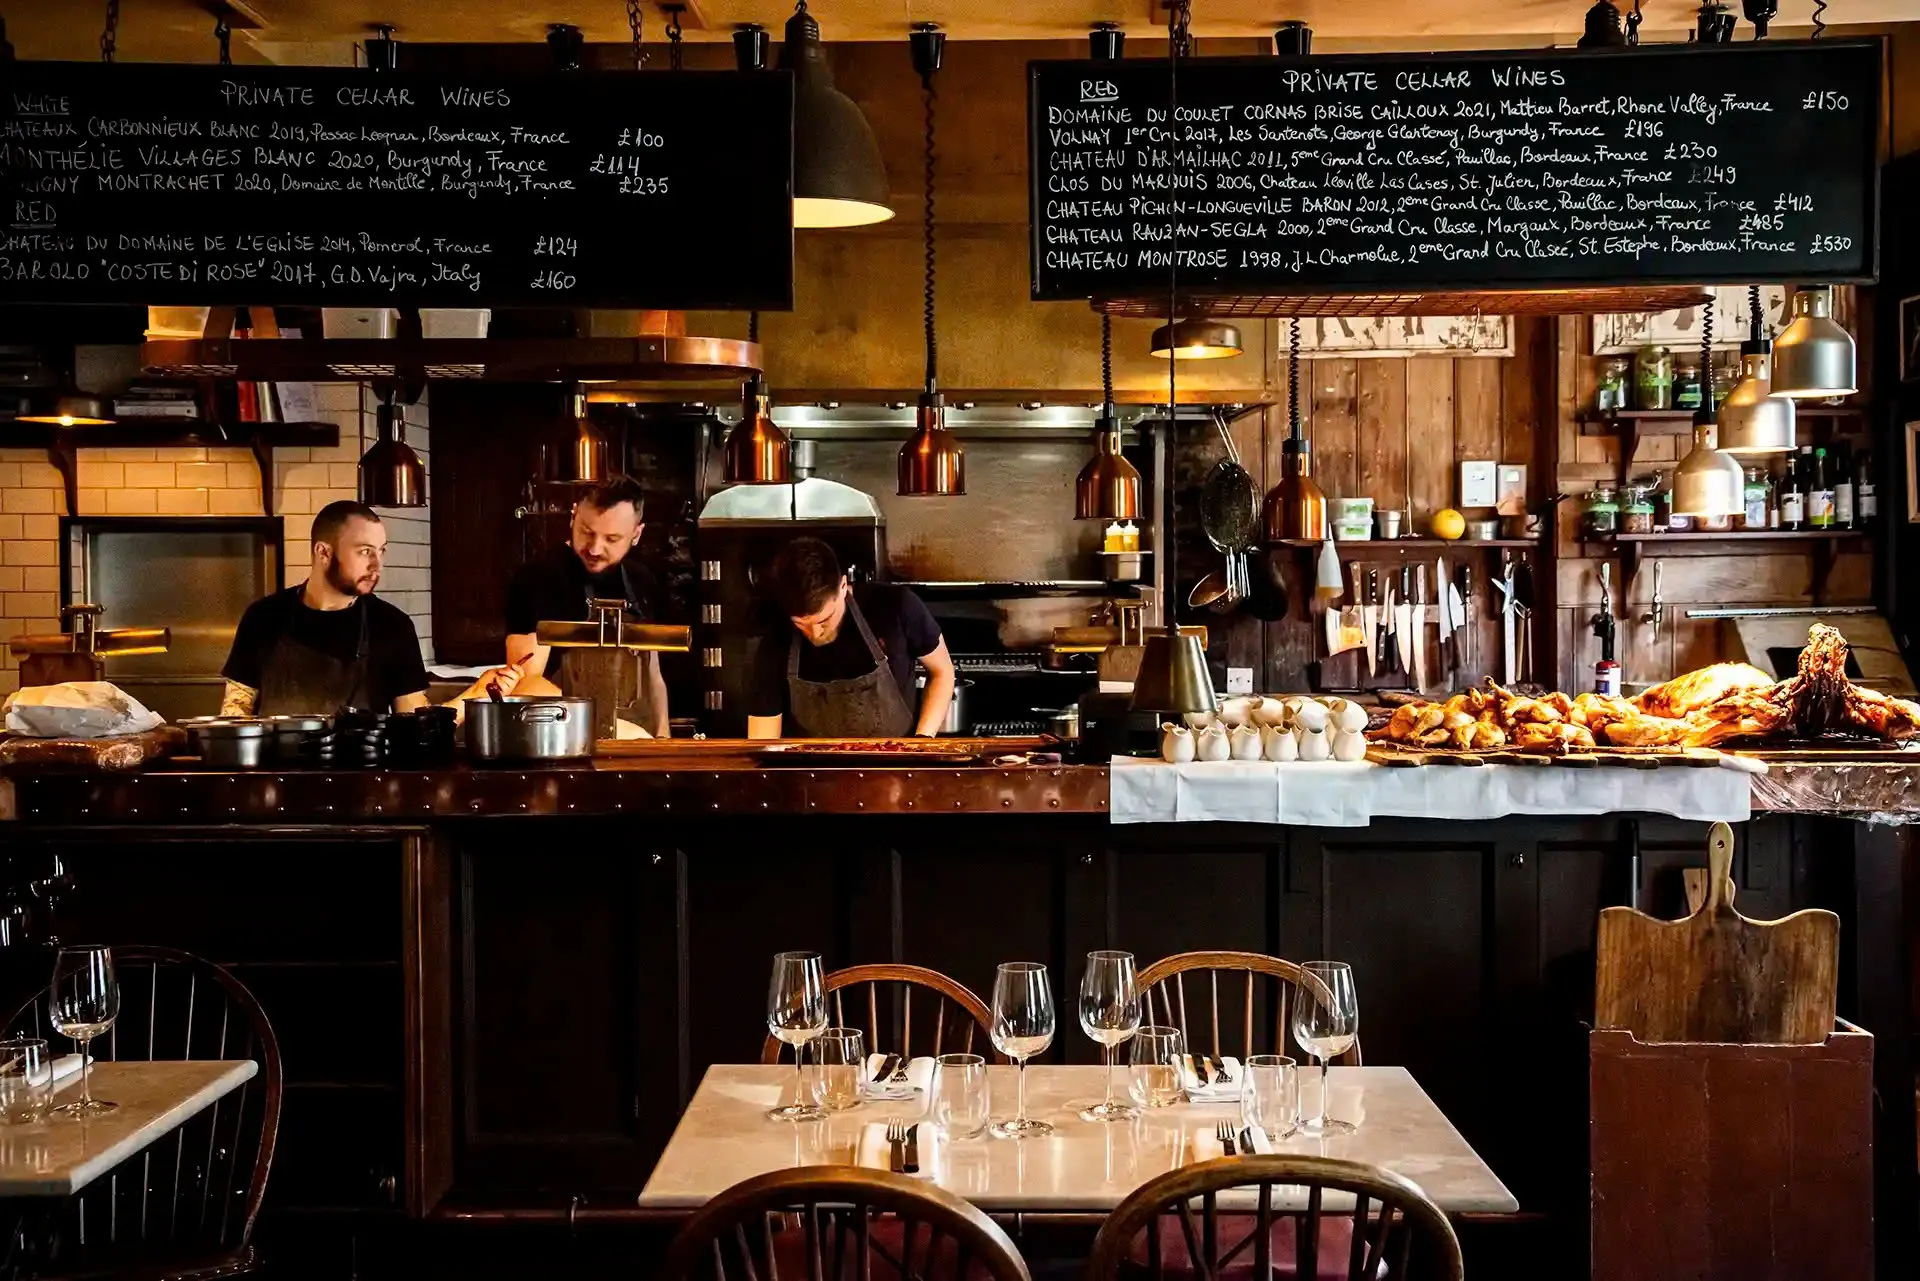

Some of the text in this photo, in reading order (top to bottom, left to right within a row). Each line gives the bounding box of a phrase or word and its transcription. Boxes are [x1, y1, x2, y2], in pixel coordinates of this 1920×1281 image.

[221, 80, 511, 107] PRIVATE CELLAR WINES
[1080, 80, 1119, 99] RED
[1282, 66, 1565, 93] PRIVATE CELLAR WINES
[13, 92, 70, 113] WHITE
[1049, 105, 1132, 124] DOMAINE
[1147, 107, 1167, 122] DU
[1174, 105, 1234, 122] COULET
[1244, 104, 1307, 120] CORNAS
[1314, 101, 1364, 120] BRISE
[1370, 100, 1449, 120] CAILLOUX
[1453, 100, 1496, 121] 2021,
[1617, 96, 1667, 114] Rhone
[1669, 93, 1722, 124] Valley,
[1721, 93, 1773, 113] France
[1803, 91, 1849, 110] £150
[88, 116, 201, 137] CARBONNIEUX
[211, 120, 260, 138] BLANC
[269, 122, 309, 143] 2019,
[310, 123, 358, 142] Pessac
[429, 126, 506, 145] Bordeaux,
[510, 127, 570, 143] France
[617, 128, 664, 147] £100
[1049, 128, 1110, 147] VOLNAY
[1185, 126, 1223, 144] 2017,
[1229, 125, 1252, 142] Les
[1333, 125, 1384, 150] George
[1468, 123, 1545, 145] Burgundy,
[1549, 122, 1605, 138] France
[1624, 119, 1664, 138] £196
[138, 145, 242, 167] VILLAGES
[255, 147, 316, 166] BLANC
[328, 150, 379, 172] 2020,
[388, 150, 482, 177] Burgundy,
[486, 150, 548, 172] France
[590, 154, 640, 177] £114
[1050, 150, 1125, 172] CHATEAU
[1247, 150, 1288, 170] 2011,
[1320, 152, 1365, 167] Grand
[1368, 153, 1393, 166] Cru
[1520, 148, 1596, 165] Bordeaux,
[1595, 145, 1649, 162] France
[1664, 142, 1718, 160] £230
[98, 174, 224, 192] MONTRACHET
[234, 174, 277, 194] 2020,
[282, 174, 343, 191] Domaine
[346, 175, 364, 190] de
[441, 175, 518, 199] Burgundy,
[518, 175, 576, 192] France
[619, 176, 668, 195] £235
[1048, 175, 1089, 193] CLOS
[1101, 176, 1123, 192] DU
[1216, 173, 1256, 192] 2006,
[1259, 172, 1317, 190] Chateau
[1323, 168, 1376, 190] Léoville
[1379, 172, 1404, 190] Las
[1408, 172, 1455, 191] Cases,
[1459, 173, 1482, 190] St.
[1485, 172, 1539, 197] Julien,
[1542, 171, 1621, 189] Bordeaux,
[1620, 168, 1672, 187] France
[1687, 165, 1736, 184] £249
[15, 199, 57, 222] RED
[1047, 200, 1123, 219] CHATEAU
[1302, 196, 1352, 214] BARON
[1355, 196, 1395, 214] 2012,
[1431, 196, 1479, 211] Grand
[1480, 198, 1503, 211] Cru
[1626, 192, 1701, 213] Bordeaux,
[1774, 192, 1814, 212] £412
[1046, 225, 1123, 245] CHATEAU
[1277, 219, 1314, 238] 2000,
[1350, 217, 1395, 234] Grand
[1398, 219, 1428, 236] Cru
[1487, 216, 1567, 241] Margaux,
[1571, 213, 1653, 232] Bordeaux,
[1655, 214, 1711, 231] France
[1738, 213, 1784, 232] £485
[86, 235, 108, 251] DU
[119, 234, 195, 251] DOMAINE
[204, 236, 227, 250] DE
[236, 232, 314, 251] L'EGLISE
[320, 236, 355, 253] 2014,
[358, 232, 430, 254] Pomerol,
[433, 238, 492, 253] France
[534, 236, 577, 257] £124
[1046, 250, 1128, 270] CHATEAU
[1137, 248, 1228, 268] MONTROSE
[1239, 250, 1287, 269] 1998,
[1443, 240, 1489, 261] Grand
[1496, 240, 1521, 258] Cru
[1578, 236, 1601, 255] St.
[1671, 234, 1740, 253] Bordeaux,
[1741, 233, 1796, 253] France
[1810, 235, 1852, 254] £530
[271, 260, 325, 288] 2017,
[432, 261, 481, 291] Italy
[531, 270, 576, 290] £160
